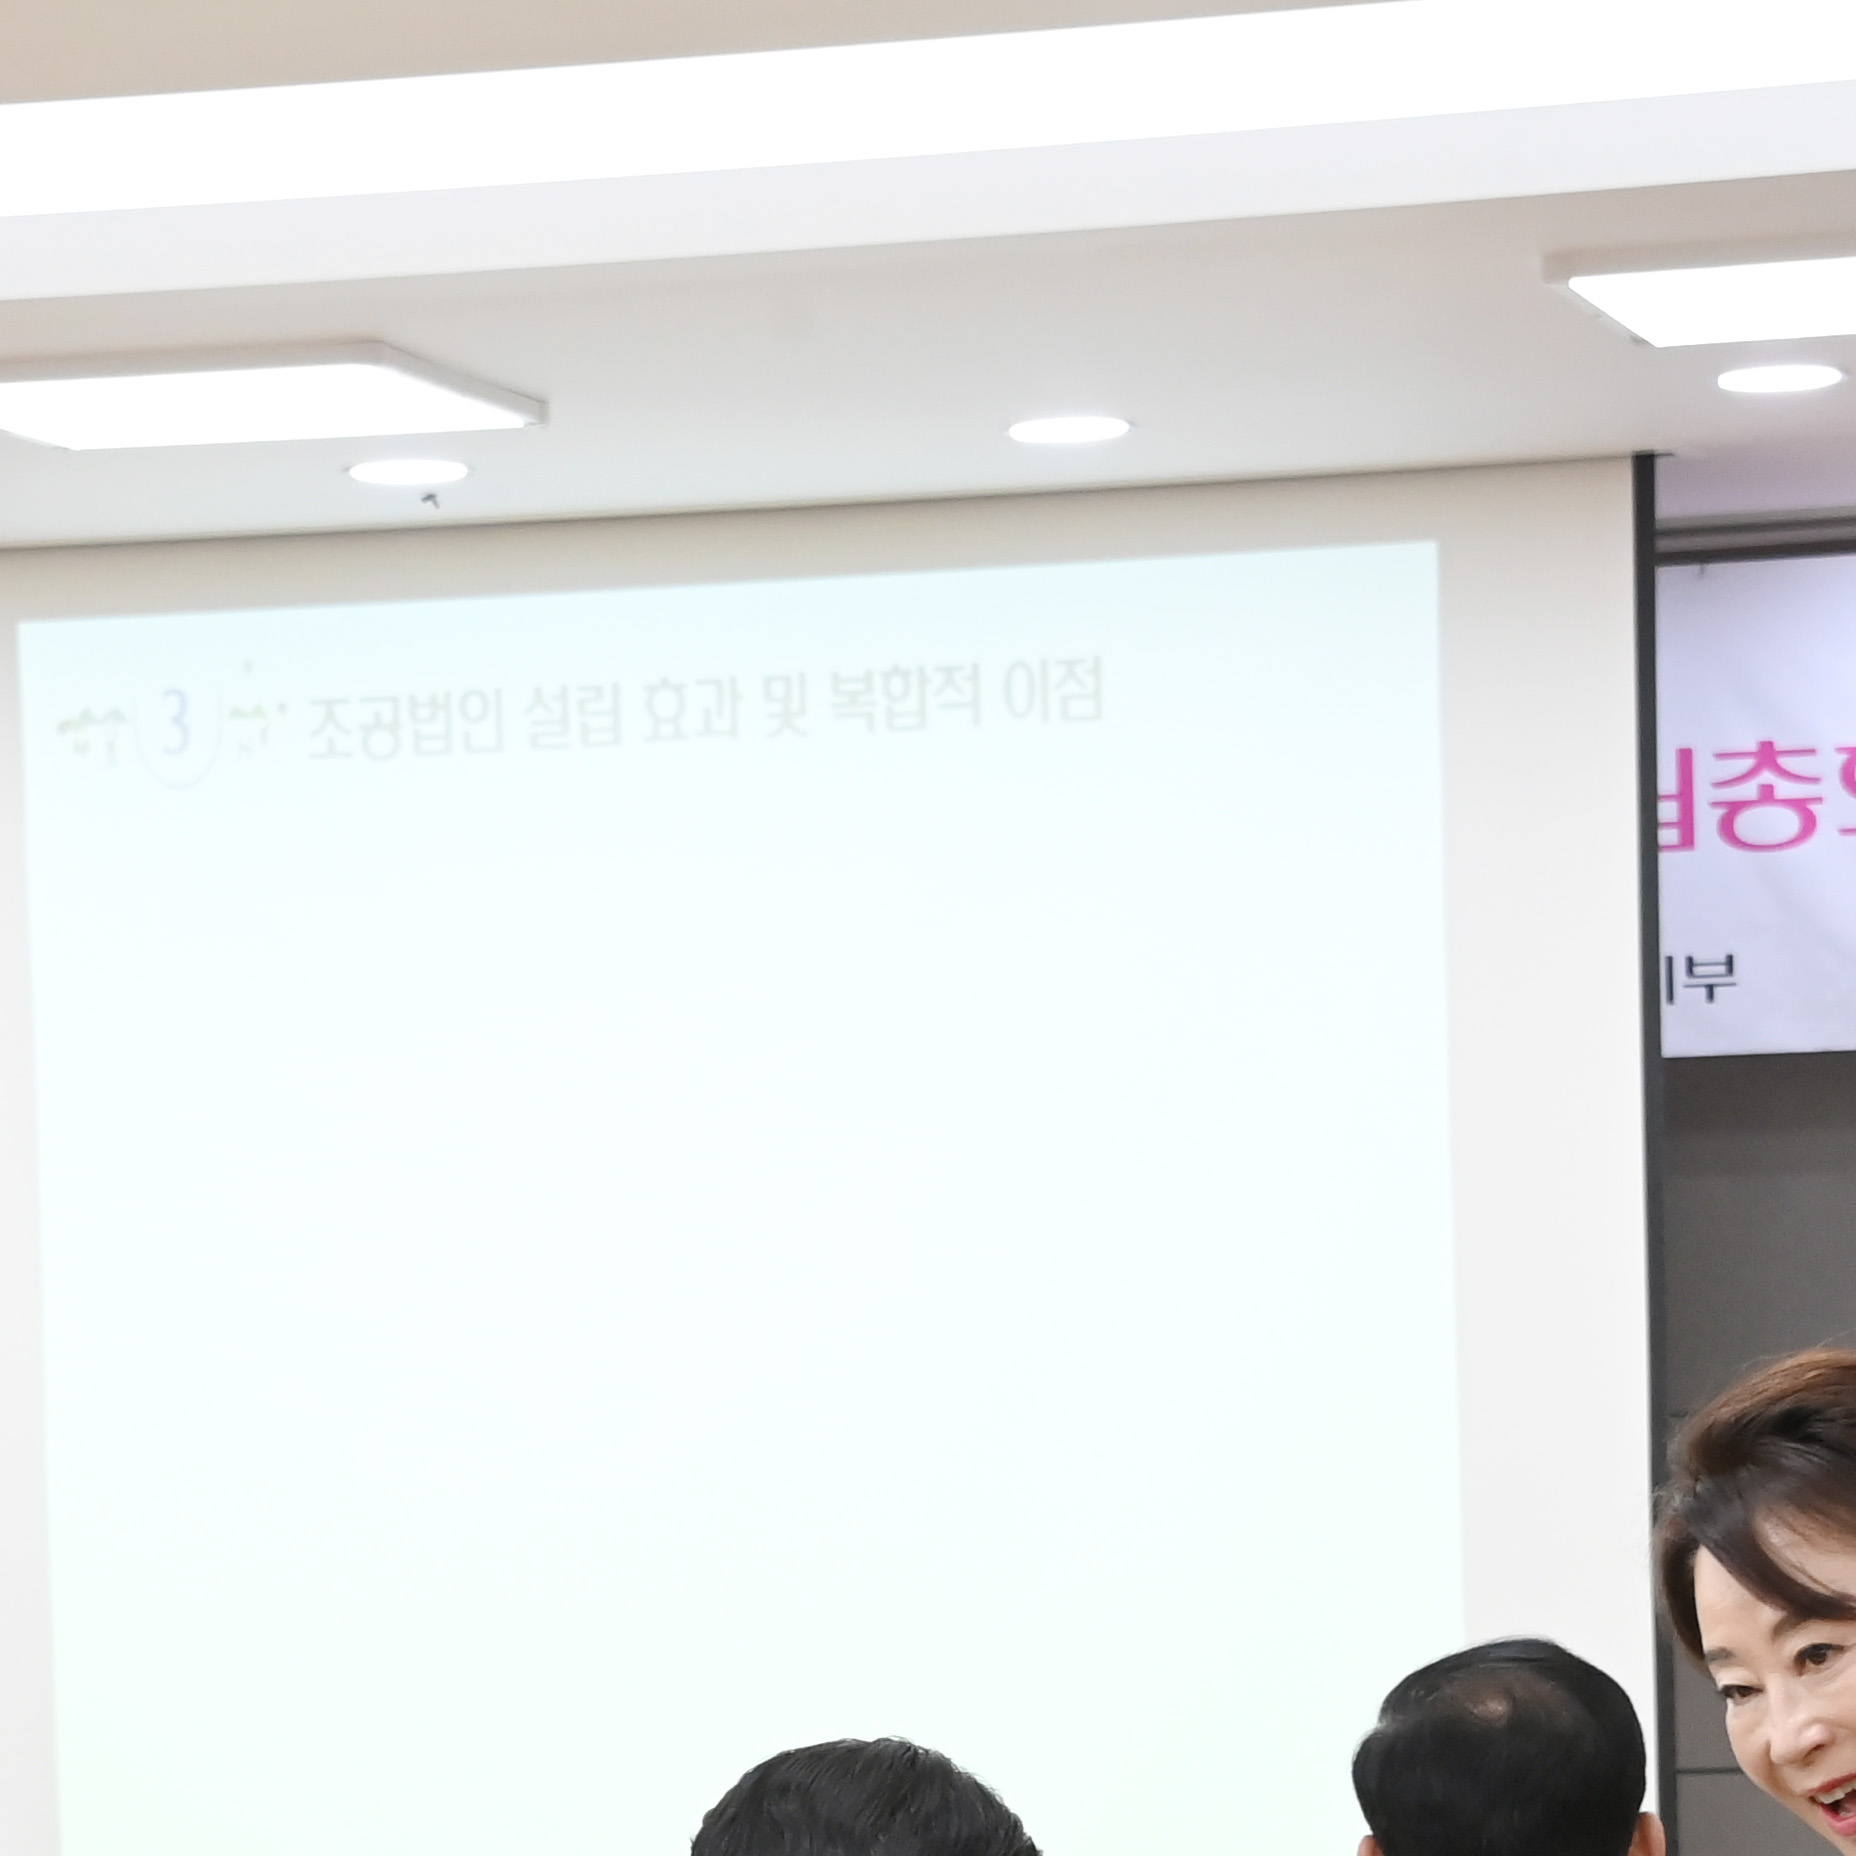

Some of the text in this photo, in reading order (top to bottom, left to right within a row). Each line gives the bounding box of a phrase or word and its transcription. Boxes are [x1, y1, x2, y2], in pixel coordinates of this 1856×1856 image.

[163, 655, 1103, 762] 3 조공법인 설립 효과 및 복합적 이점
